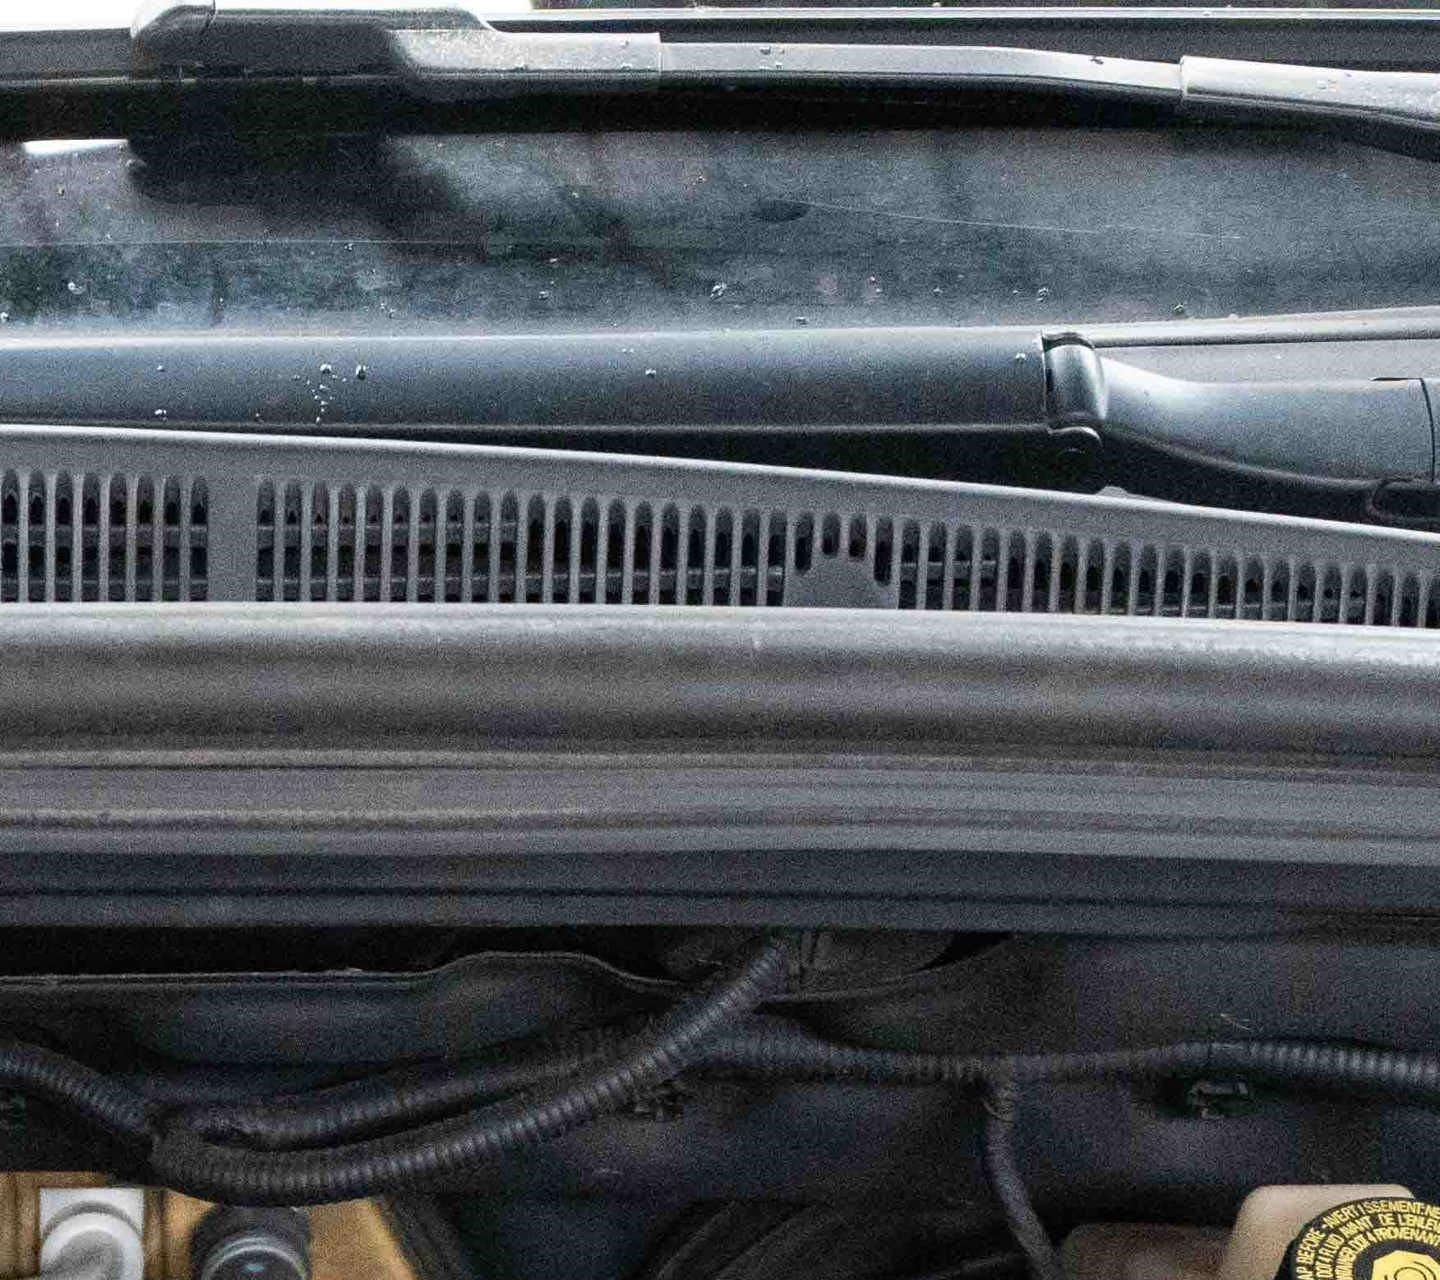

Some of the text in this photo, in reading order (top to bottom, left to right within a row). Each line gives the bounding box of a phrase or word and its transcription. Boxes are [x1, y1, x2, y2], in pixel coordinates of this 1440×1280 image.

[1335, 1215, 1377, 1240] AVANT
[1376, 1213, 1397, 1227] DE
[1296, 1226, 1328, 1265] BEFORE
[1318, 1232, 1348, 1259] FLUID
[1348, 1234, 1375, 1253] DOT
[1317, 1254, 1336, 1265] 4
[1316, 1261, 1336, 1278] DOT
